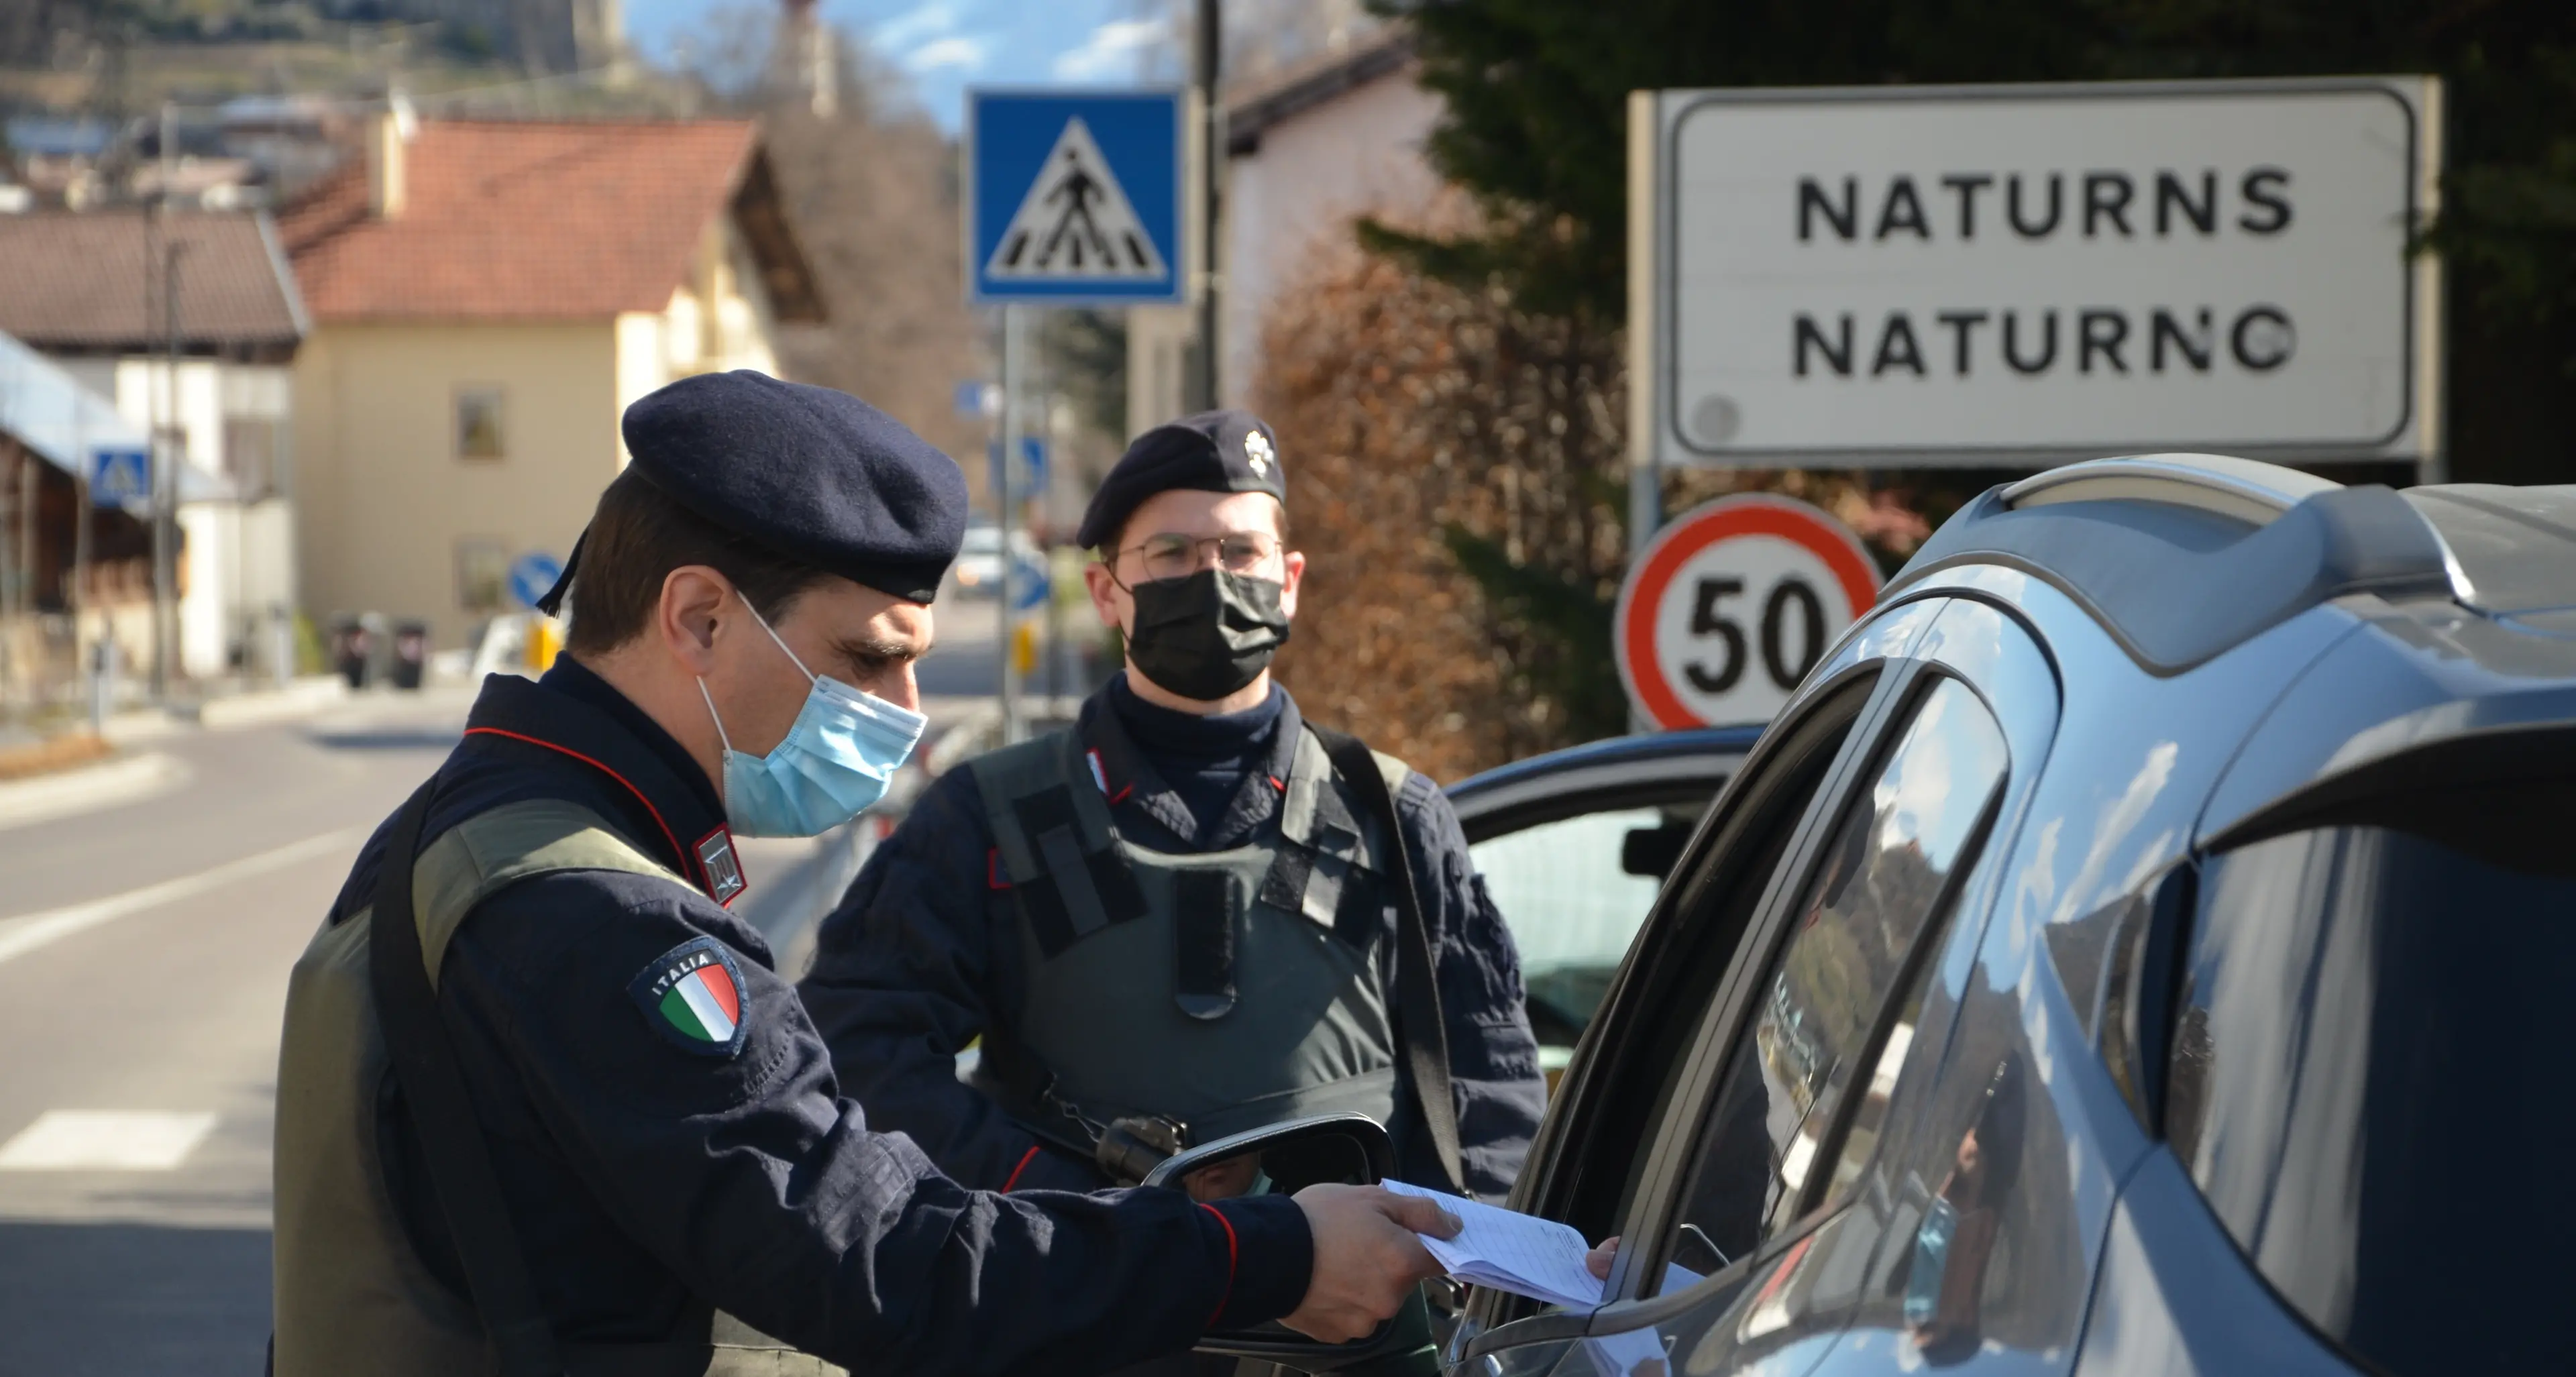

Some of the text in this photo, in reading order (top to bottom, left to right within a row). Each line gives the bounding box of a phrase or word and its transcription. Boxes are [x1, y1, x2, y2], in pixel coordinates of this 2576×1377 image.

[1796, 167, 2294, 241] NATURNS
[1684, 578, 1825, 694] 50
[652, 953, 709, 995] ITALIA
